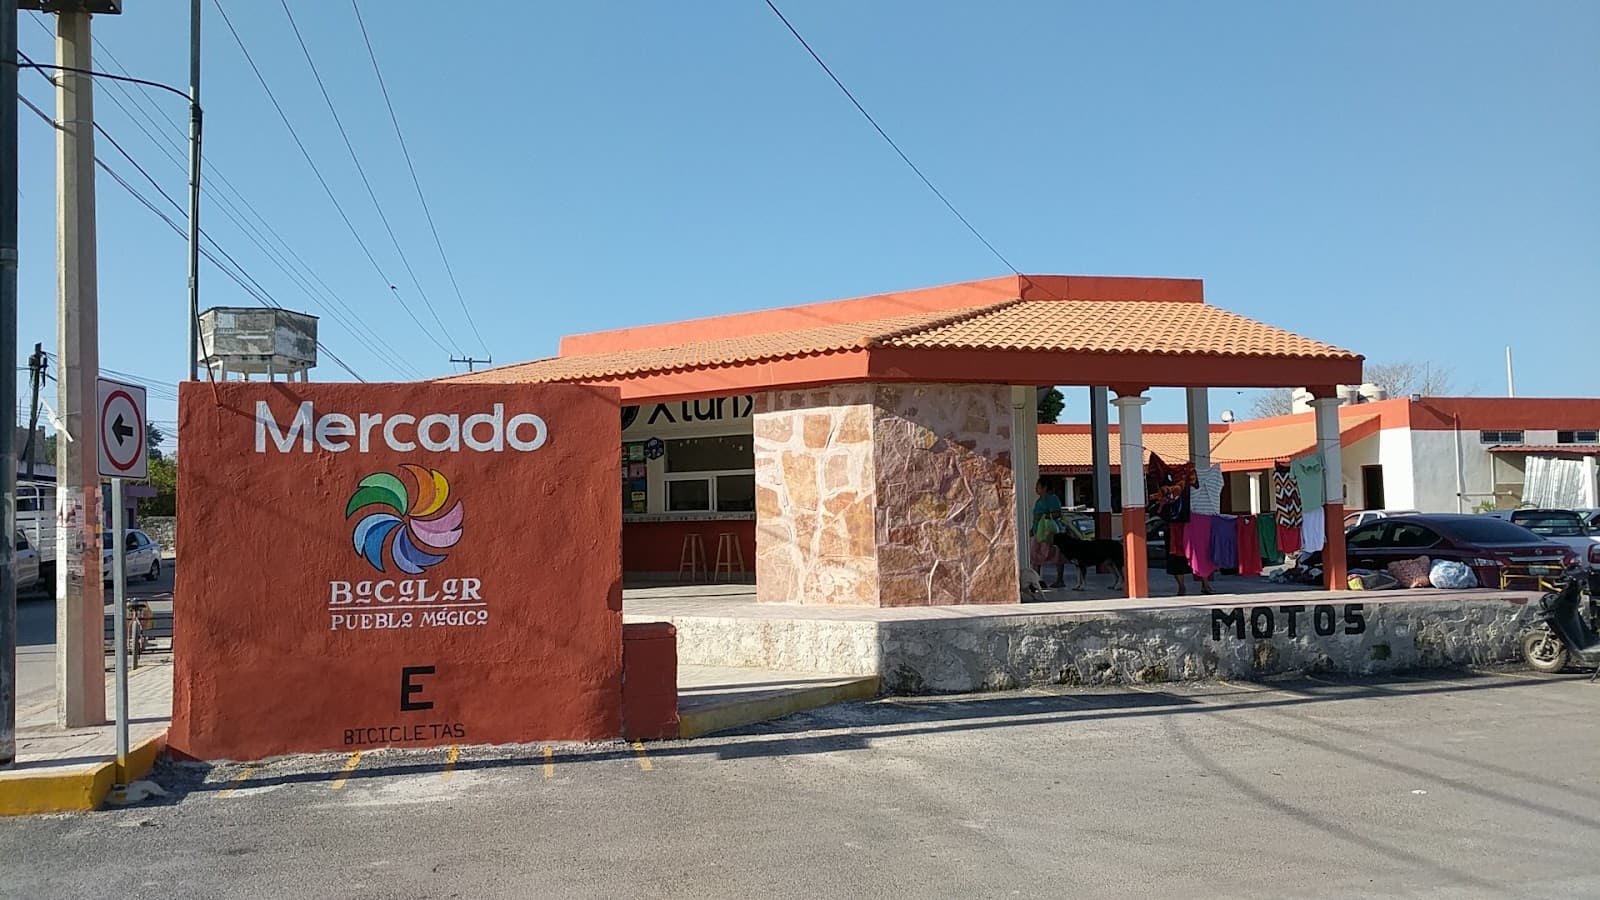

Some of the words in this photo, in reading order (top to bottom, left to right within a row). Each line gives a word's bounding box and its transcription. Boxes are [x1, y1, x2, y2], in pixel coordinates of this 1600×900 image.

[255, 400, 548, 453] Mercado
[1211, 603, 1366, 641] MOTOS
[400, 665, 436, 712] E
[343, 723, 466, 746] BICICLETAS
